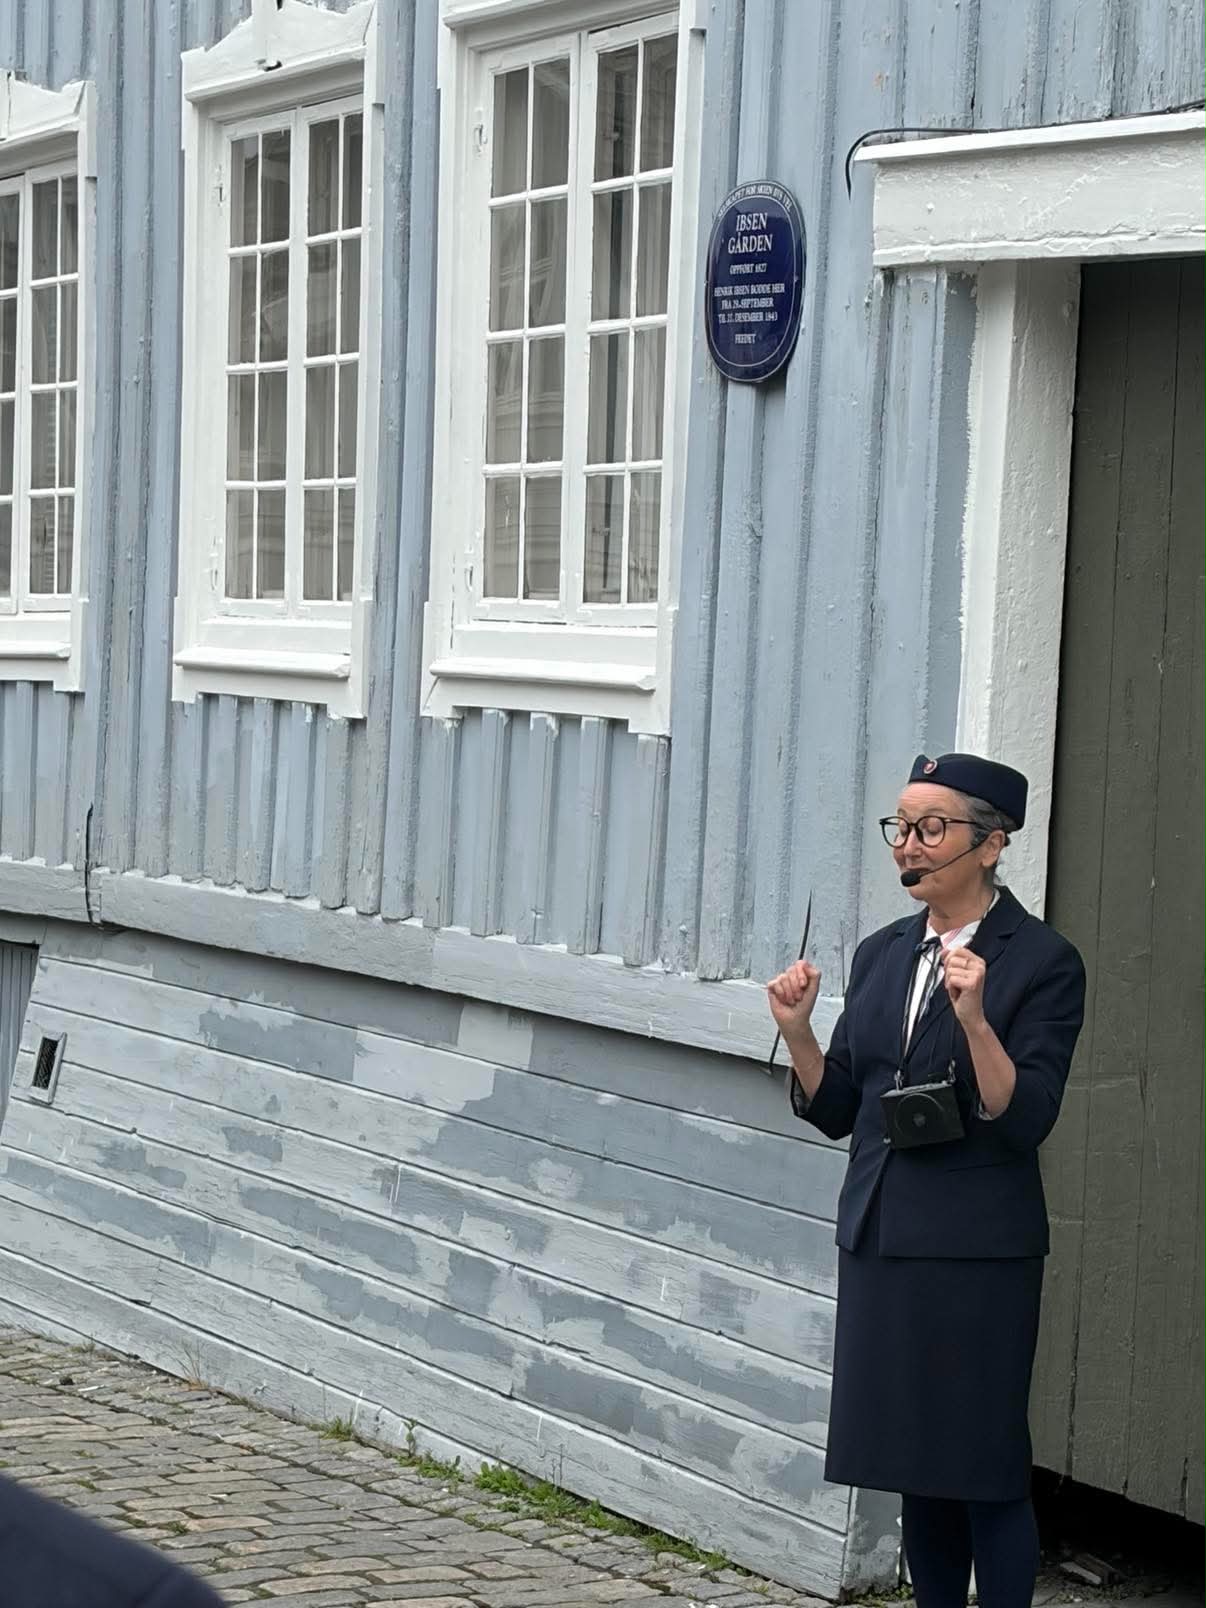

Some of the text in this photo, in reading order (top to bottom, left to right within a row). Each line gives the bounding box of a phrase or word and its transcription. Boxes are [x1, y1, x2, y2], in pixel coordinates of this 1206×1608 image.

[735, 212, 768, 232] IBSEN
[727, 232, 773, 255] GÅRDEN
[733, 284, 750, 296] IBSEN
